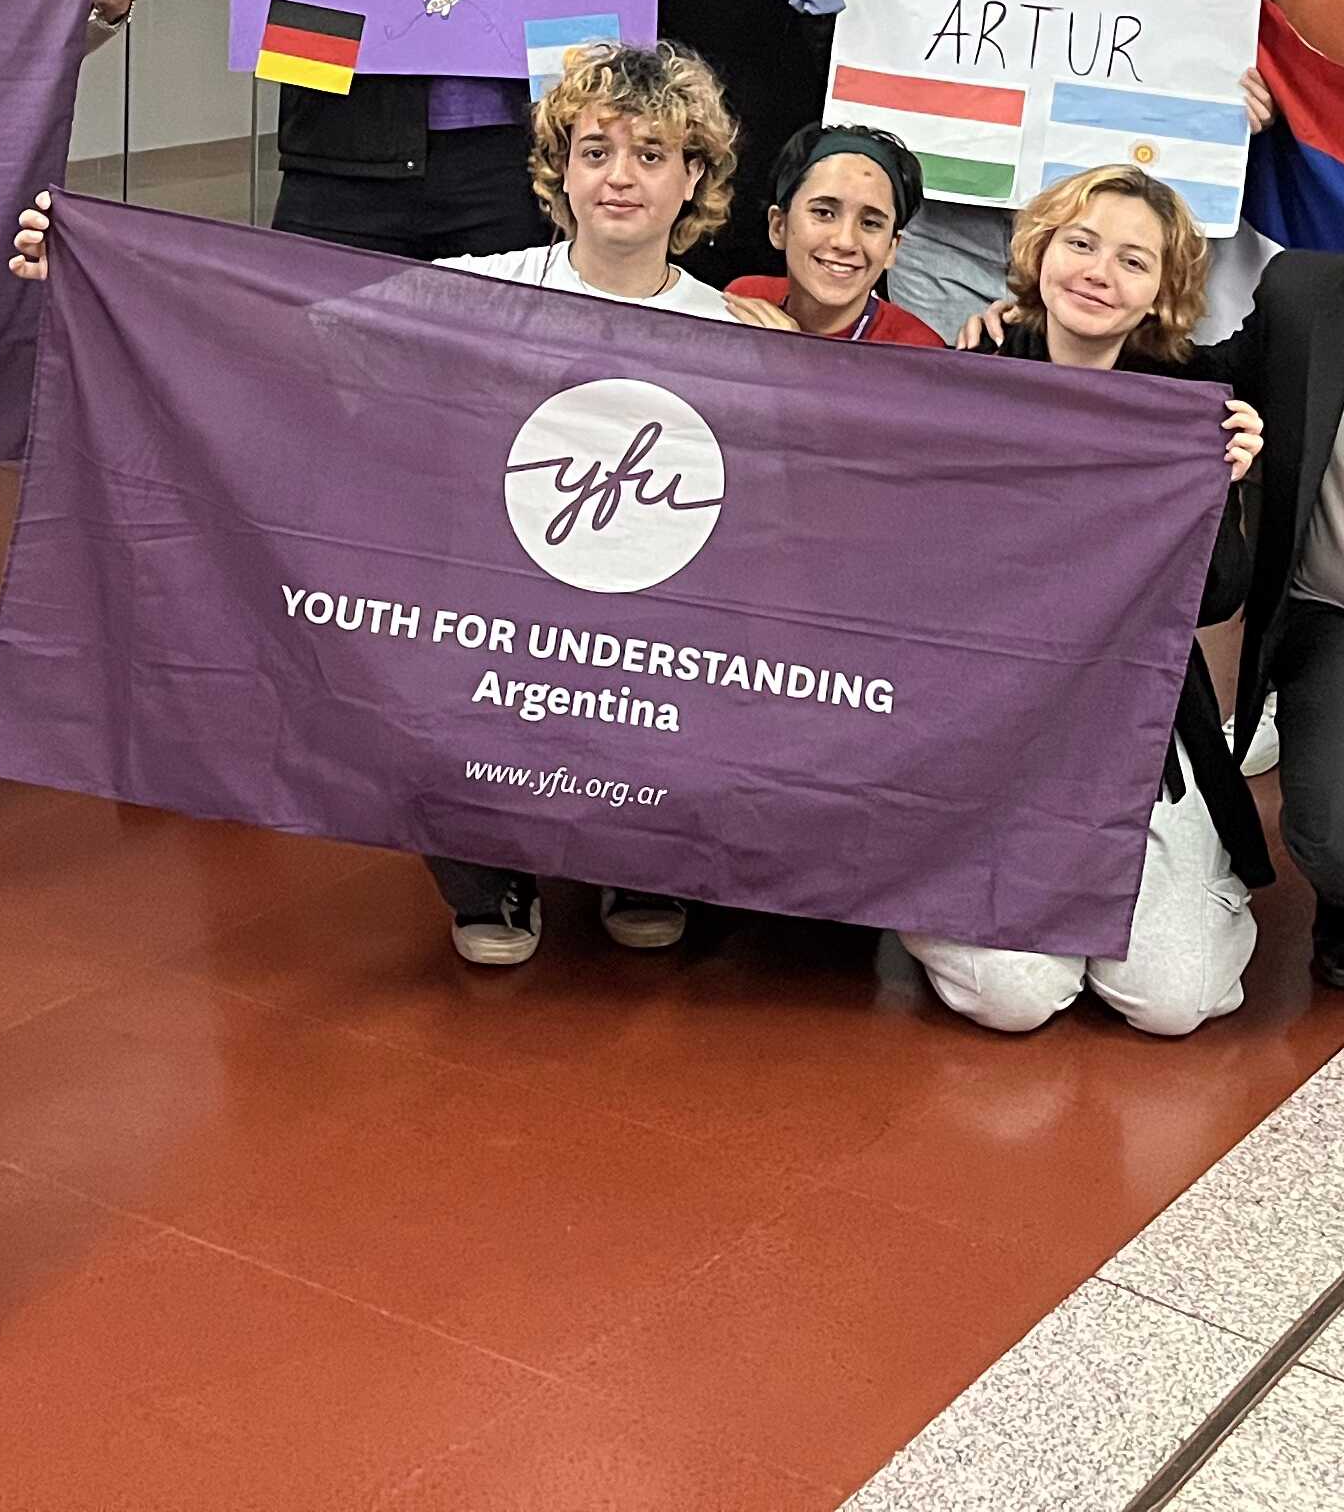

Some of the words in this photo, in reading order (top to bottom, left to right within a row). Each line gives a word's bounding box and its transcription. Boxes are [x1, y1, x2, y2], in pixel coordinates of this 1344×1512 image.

[508, 421, 721, 545] yfu
[280, 584, 421, 639] YOUTH
[432, 611, 515, 654] FOR
[527, 624, 895, 715] UNDERSTANDING
[472, 670, 680, 733] Argentina
[464, 760, 667, 808] www.yfu.org.ar
